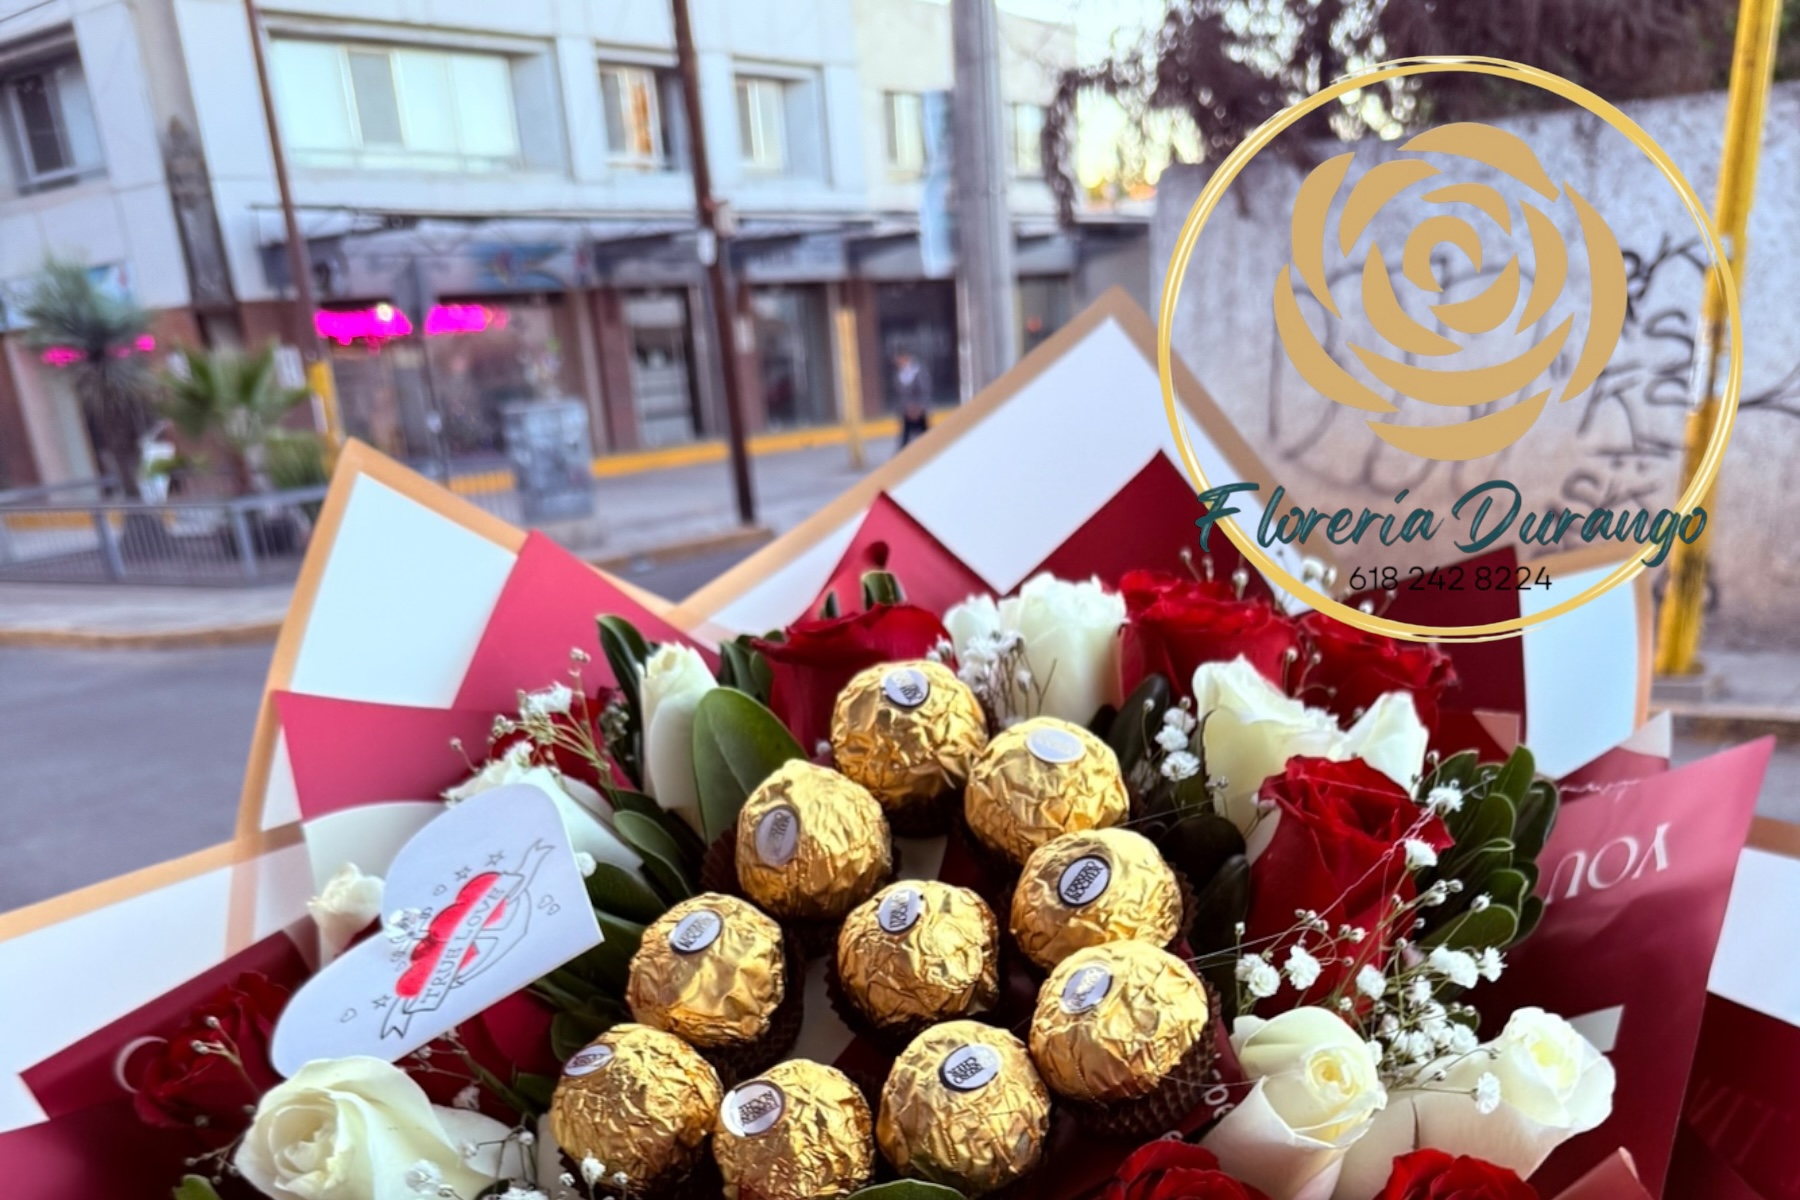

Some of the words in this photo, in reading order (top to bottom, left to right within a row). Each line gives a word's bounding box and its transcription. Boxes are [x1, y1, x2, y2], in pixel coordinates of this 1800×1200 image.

[1544, 822, 1671, 905] YOU
[419, 947, 465, 1004] TRUE
[455, 886, 505, 941] LOVE
